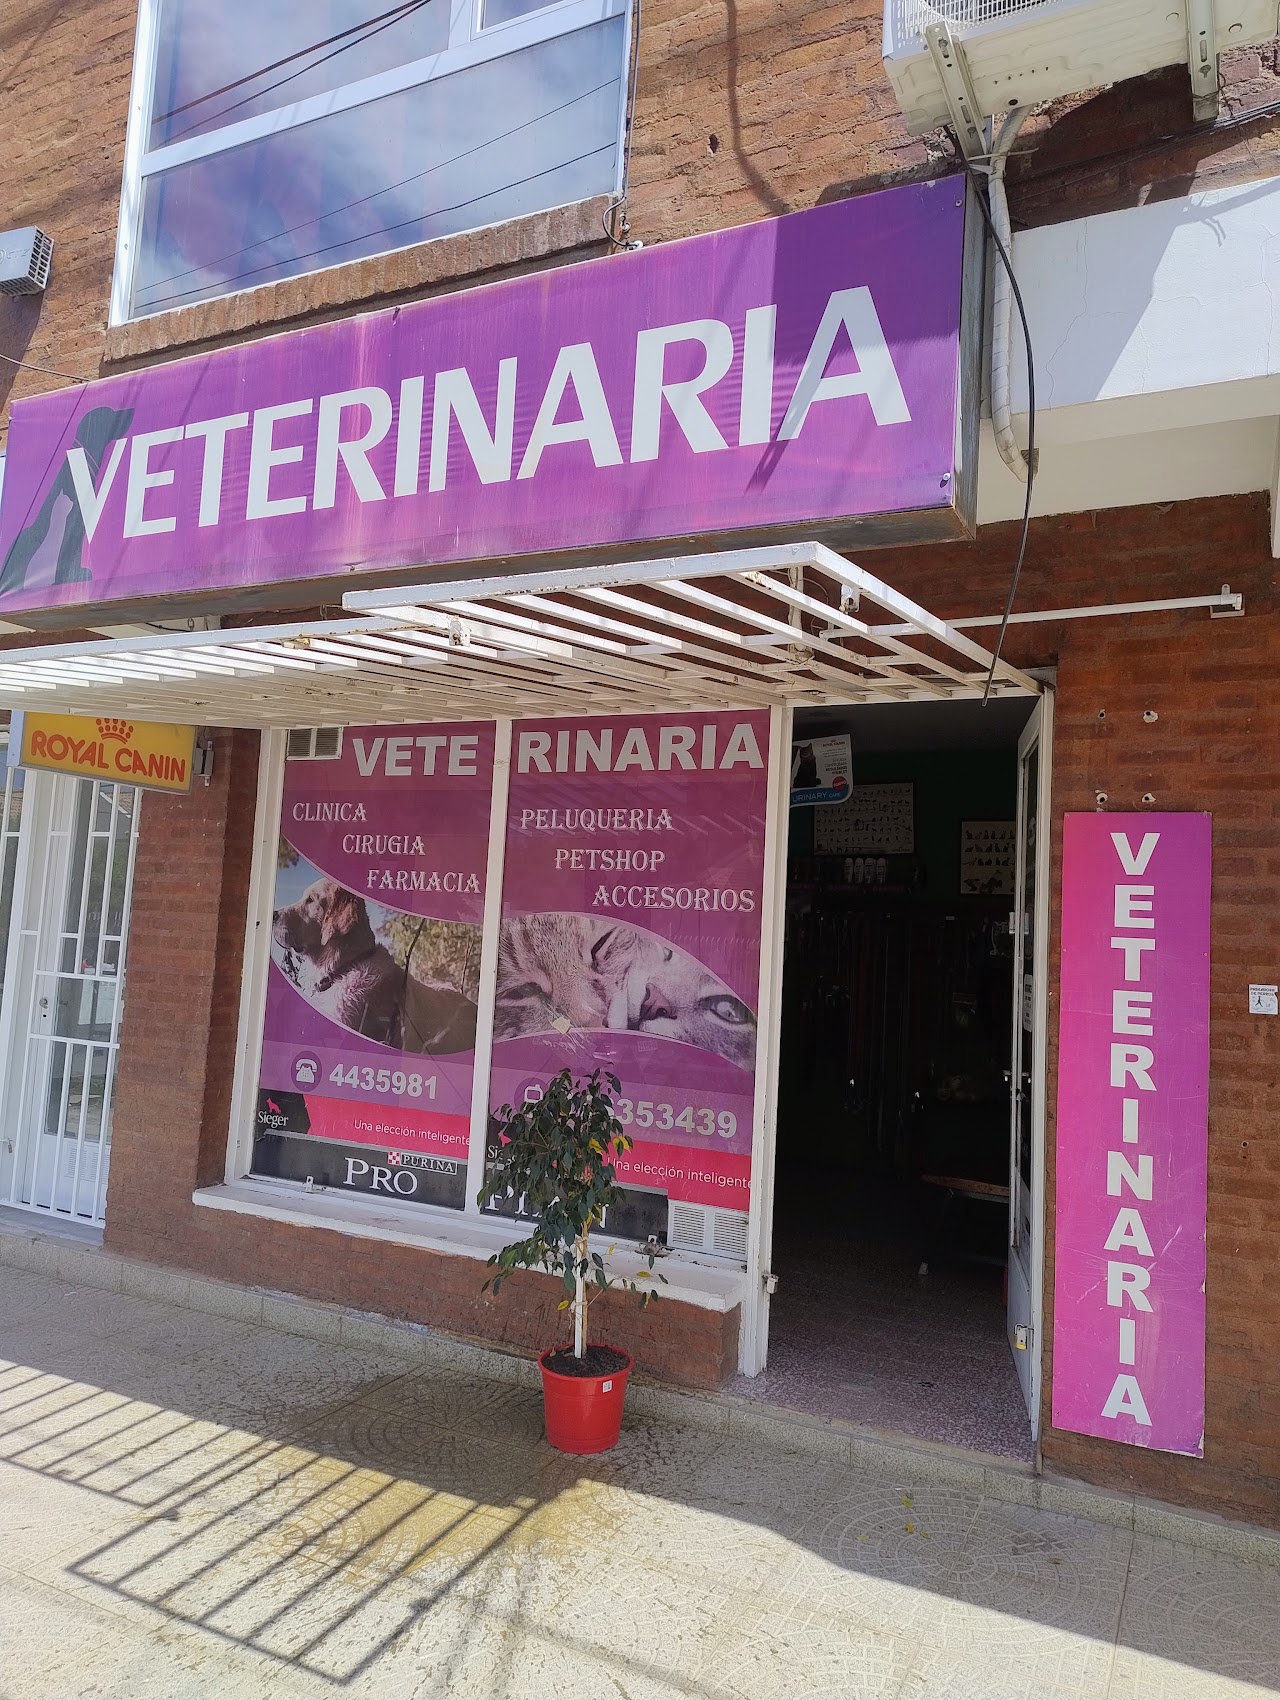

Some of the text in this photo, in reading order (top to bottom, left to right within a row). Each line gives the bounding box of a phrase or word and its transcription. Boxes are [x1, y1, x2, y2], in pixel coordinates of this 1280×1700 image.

[65, 285, 912, 546] VETERINARIA
[31, 730, 186, 783] ROYAL CANIN
[352, 723, 765, 777] VETE RINARIA
[792, 792, 828, 802] URINARY
[292, 802, 368, 822] CLINICA
[520, 808, 675, 831] PELUQUERIA
[342, 834, 427, 856] CIRUGIA
[554, 848, 666, 872] PETSHOP
[366, 869, 482, 894] FARMACIA
[591, 884, 756, 913] ACCESORIOS
[329, 1063, 438, 1100] 4435981
[257, 1110, 289, 1129] Sieger
[566, 1091, 739, 1139] 353439
[354, 1119, 470, 1146] Una elección inteligente
[1100, 832, 1160, 1427] VETERINARIA
[343, 1157, 418, 1195] PRO
[402, 1154, 455, 1173] PURINA
[633, 1161, 684, 1179] elección
